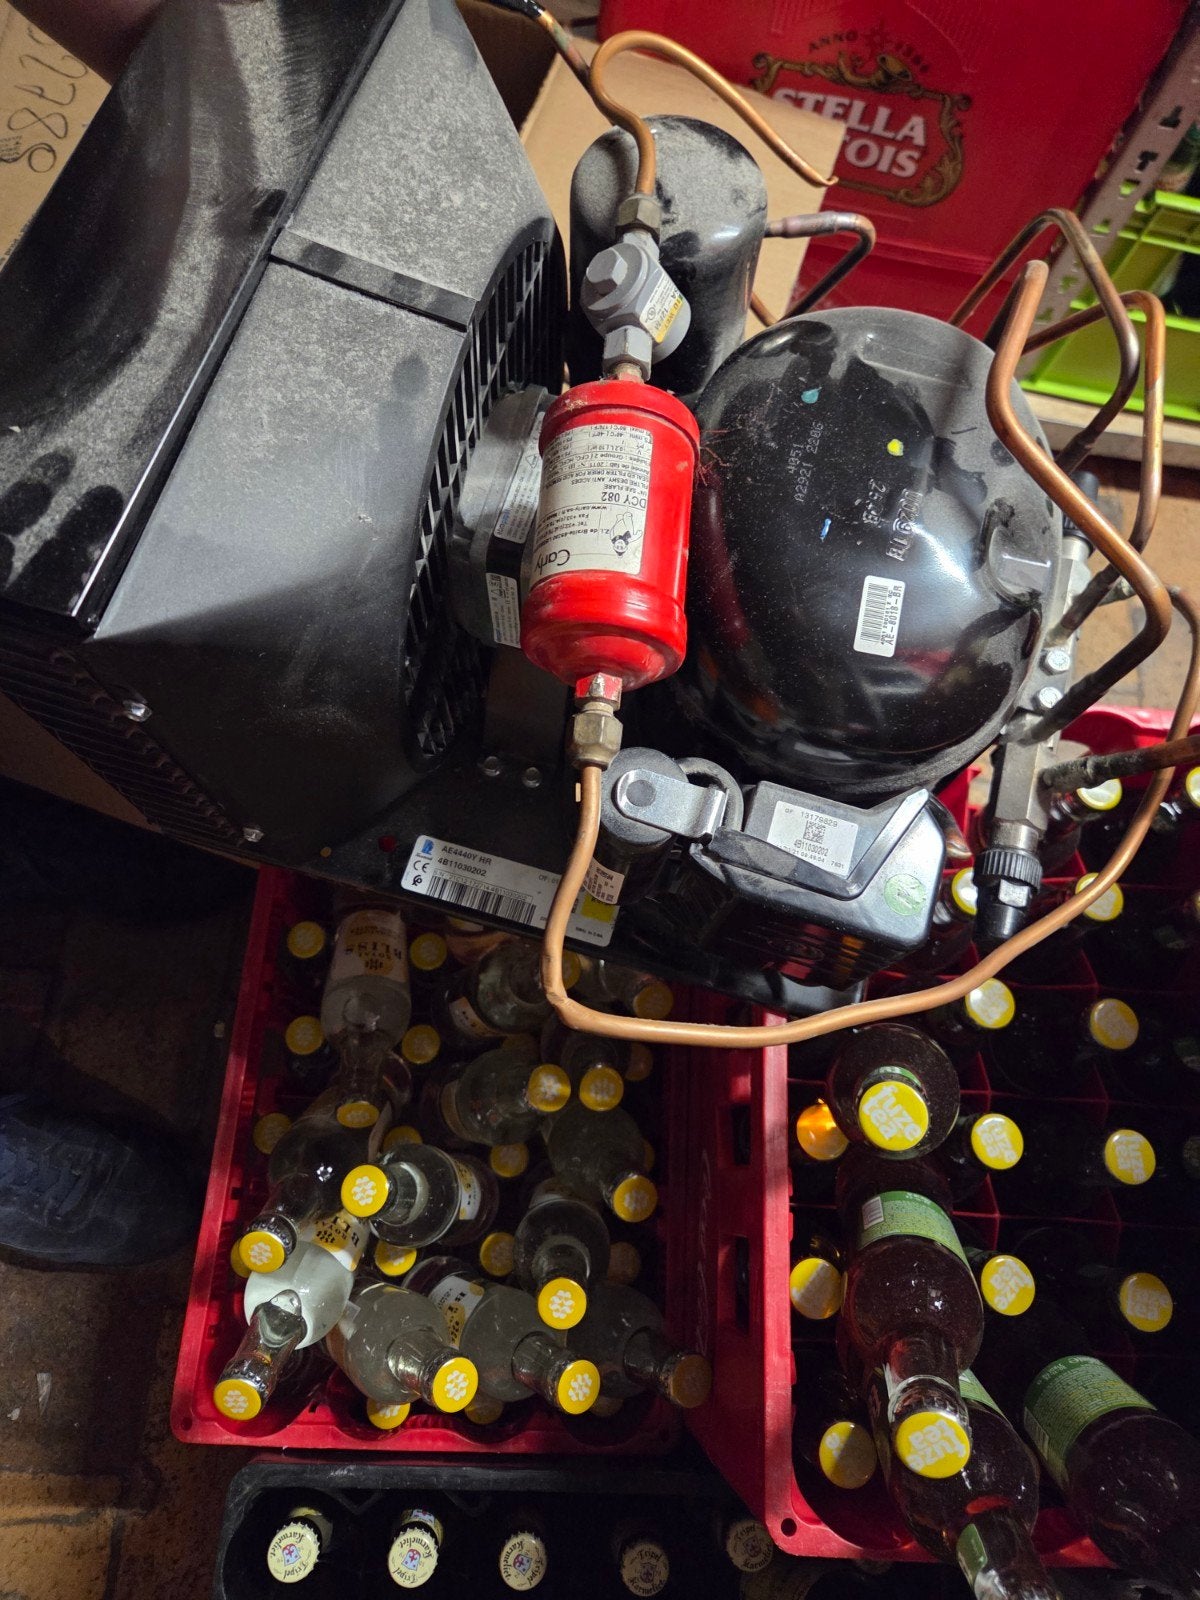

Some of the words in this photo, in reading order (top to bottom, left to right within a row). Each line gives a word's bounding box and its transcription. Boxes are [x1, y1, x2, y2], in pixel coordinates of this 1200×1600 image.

[600, 453, 624, 461] Groupe
[606, 470, 628, 478] FILTER
[604, 483, 625, 492] FLARE
[601, 491, 621, 503] 082
[623, 494, 647, 509] DCY
[534, 549, 571, 576] Carly
[441, 845, 479, 861] AE4440Y
[478, 856, 493, 866] HR
[437, 857, 487, 877] 4B11030202
